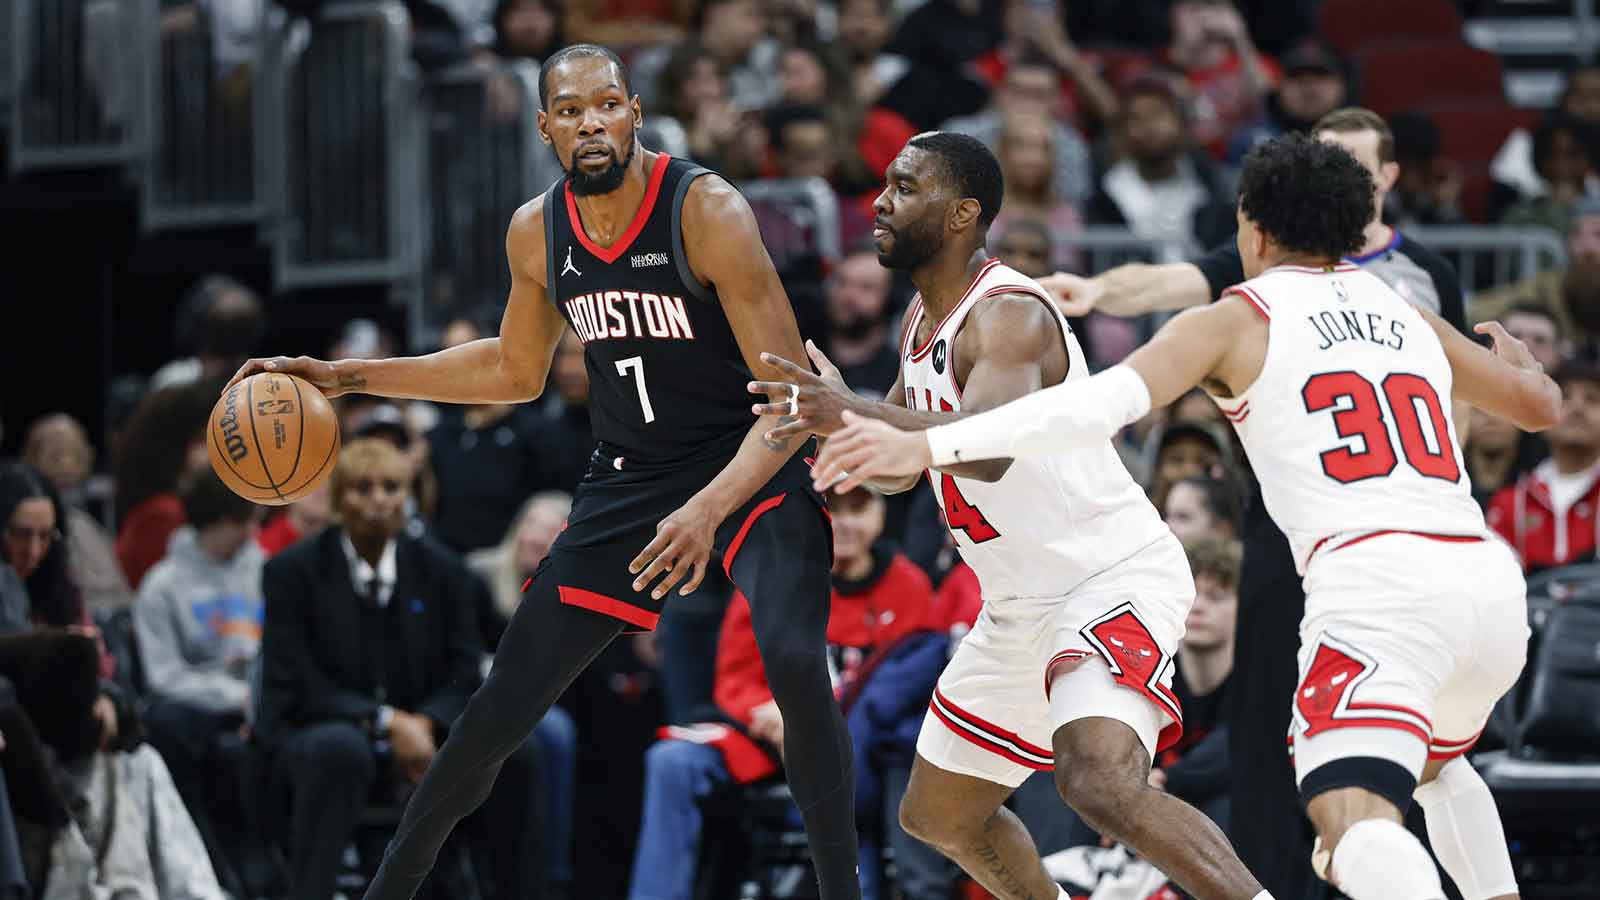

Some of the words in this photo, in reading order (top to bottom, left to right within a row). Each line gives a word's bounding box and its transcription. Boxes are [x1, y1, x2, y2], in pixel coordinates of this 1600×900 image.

[565, 290, 695, 344] HOUSTON
[1308, 310, 1405, 350] JONES
[220, 384, 247, 463] Wilson
[614, 356, 655, 424] 7
[1301, 370, 1461, 484] 30
